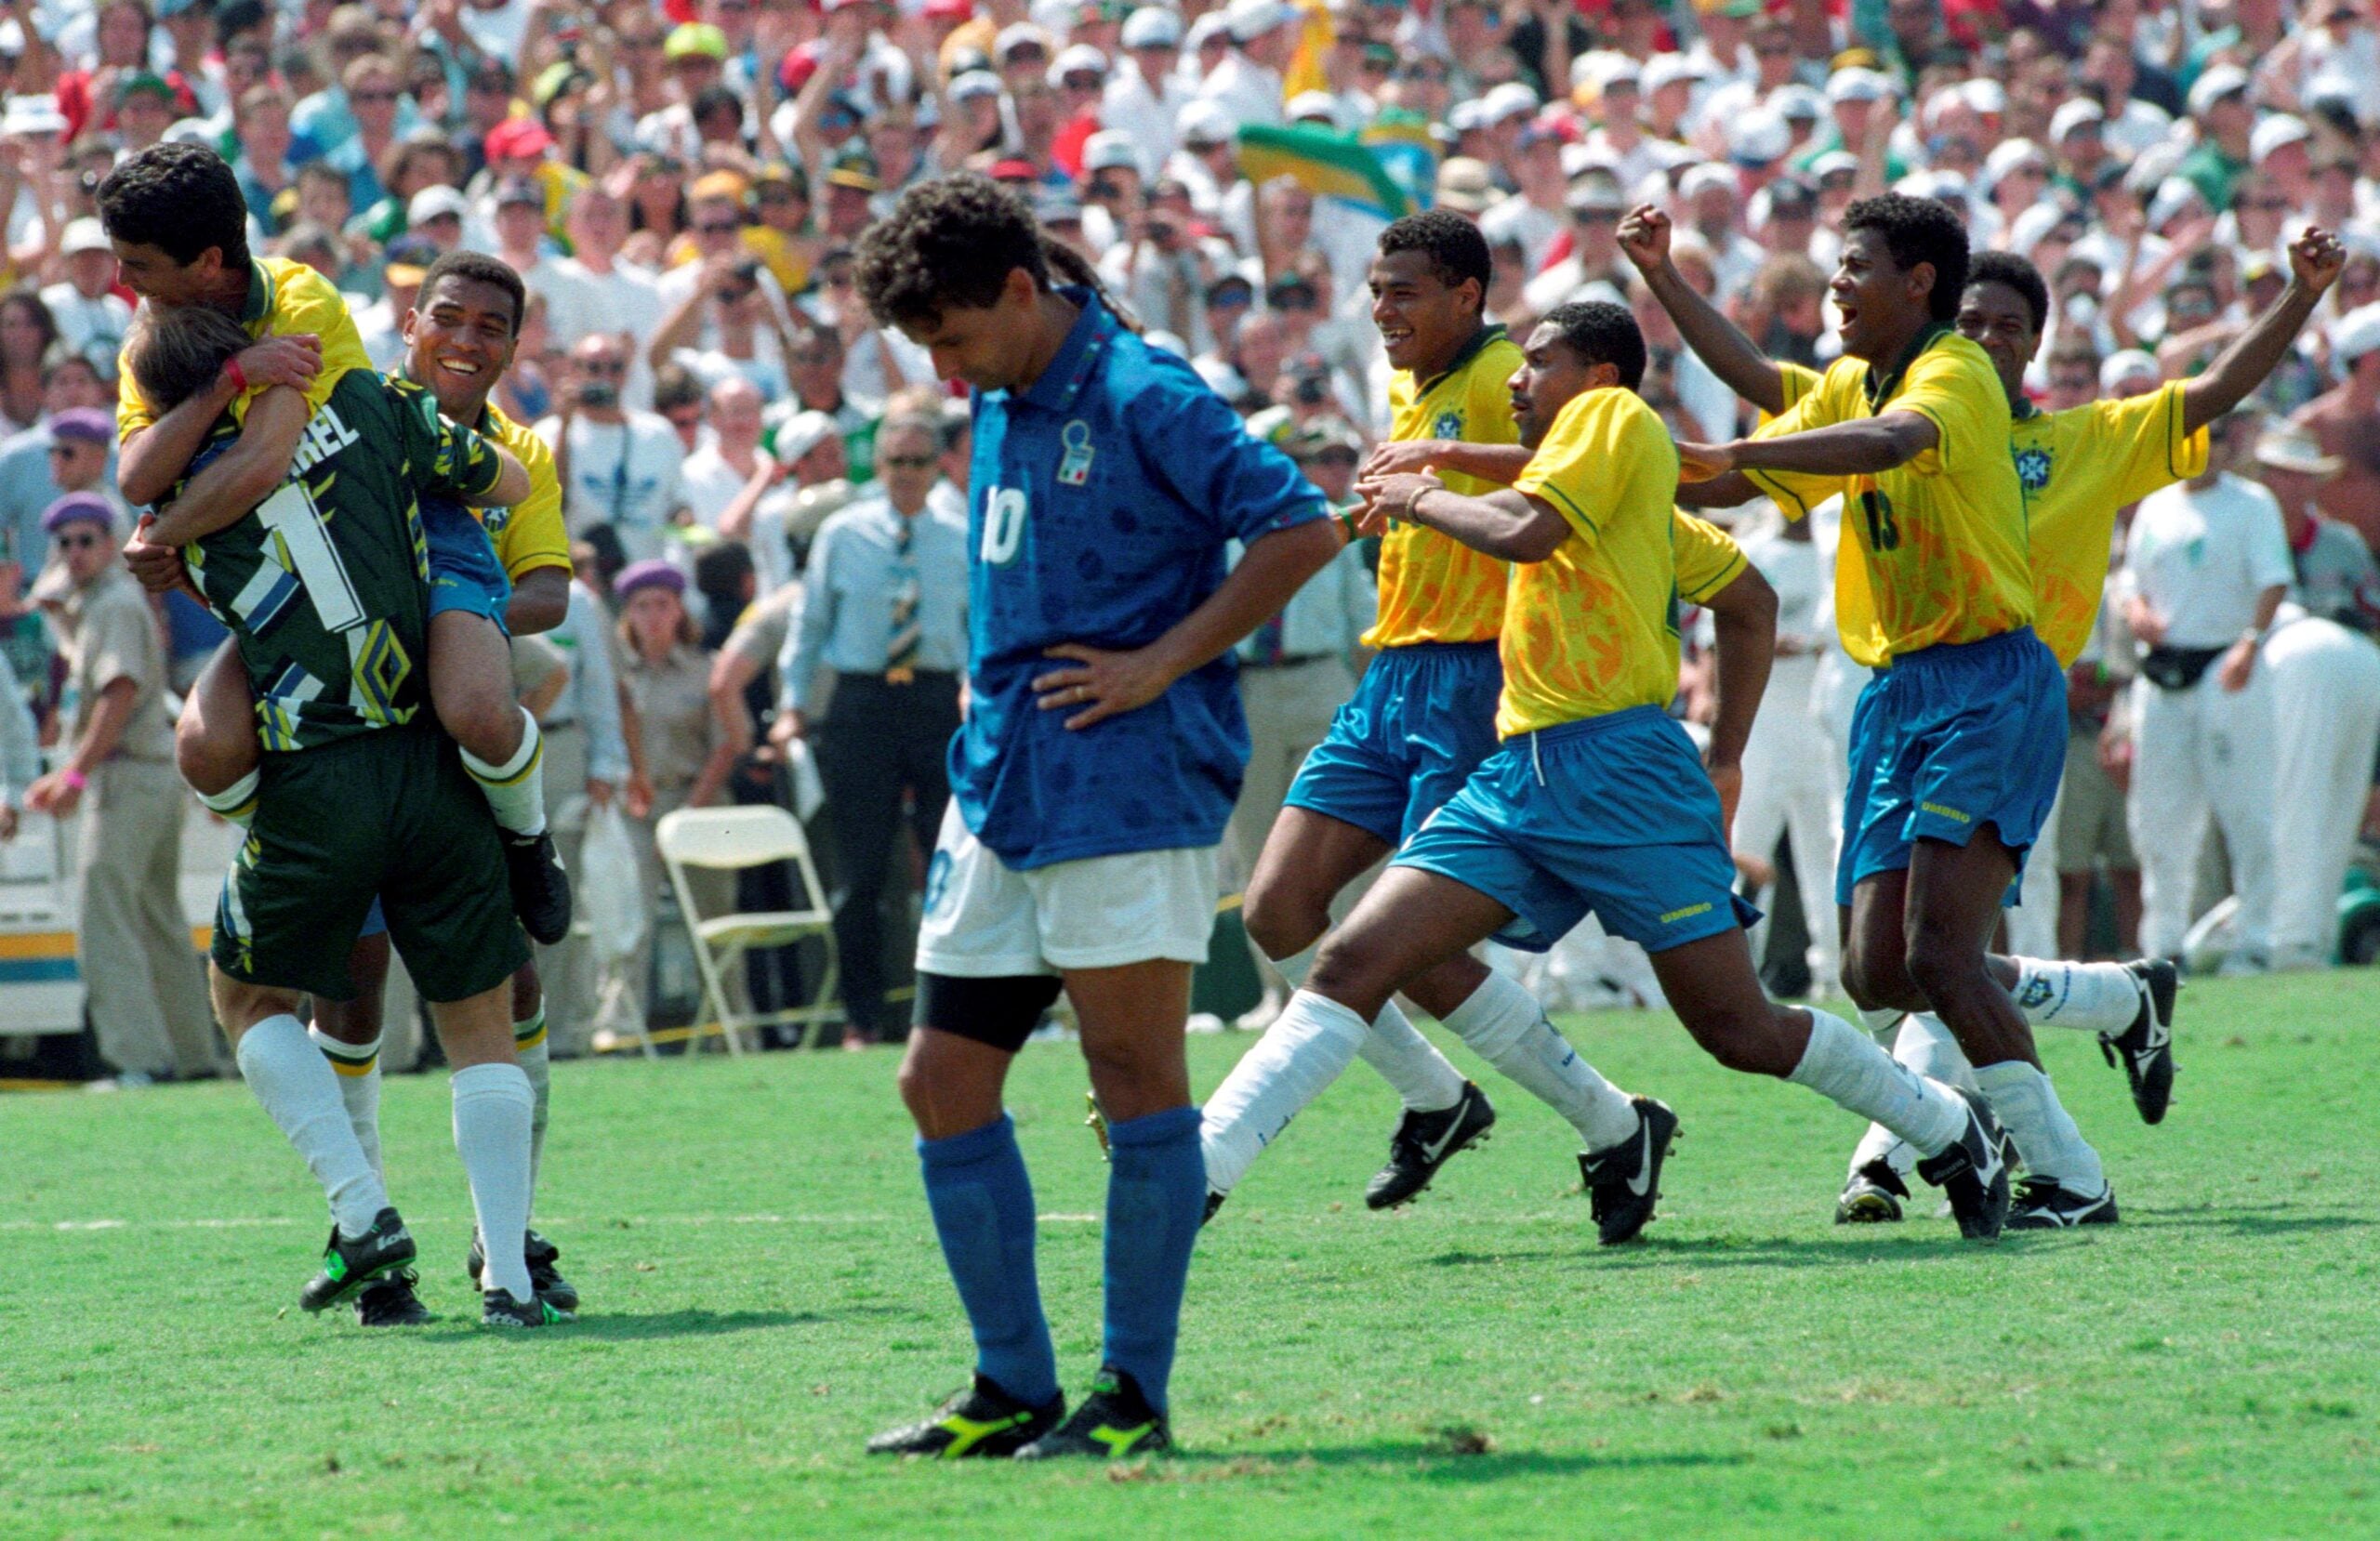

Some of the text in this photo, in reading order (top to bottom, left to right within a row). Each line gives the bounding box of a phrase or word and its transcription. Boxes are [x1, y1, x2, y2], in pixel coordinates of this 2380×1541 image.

[289, 403, 360, 476] REL
[256, 482, 366, 633] 1
[981, 484, 1027, 565] 10
[1861, 490, 1899, 553] 13
[1922, 800, 1970, 824] UMBRO
